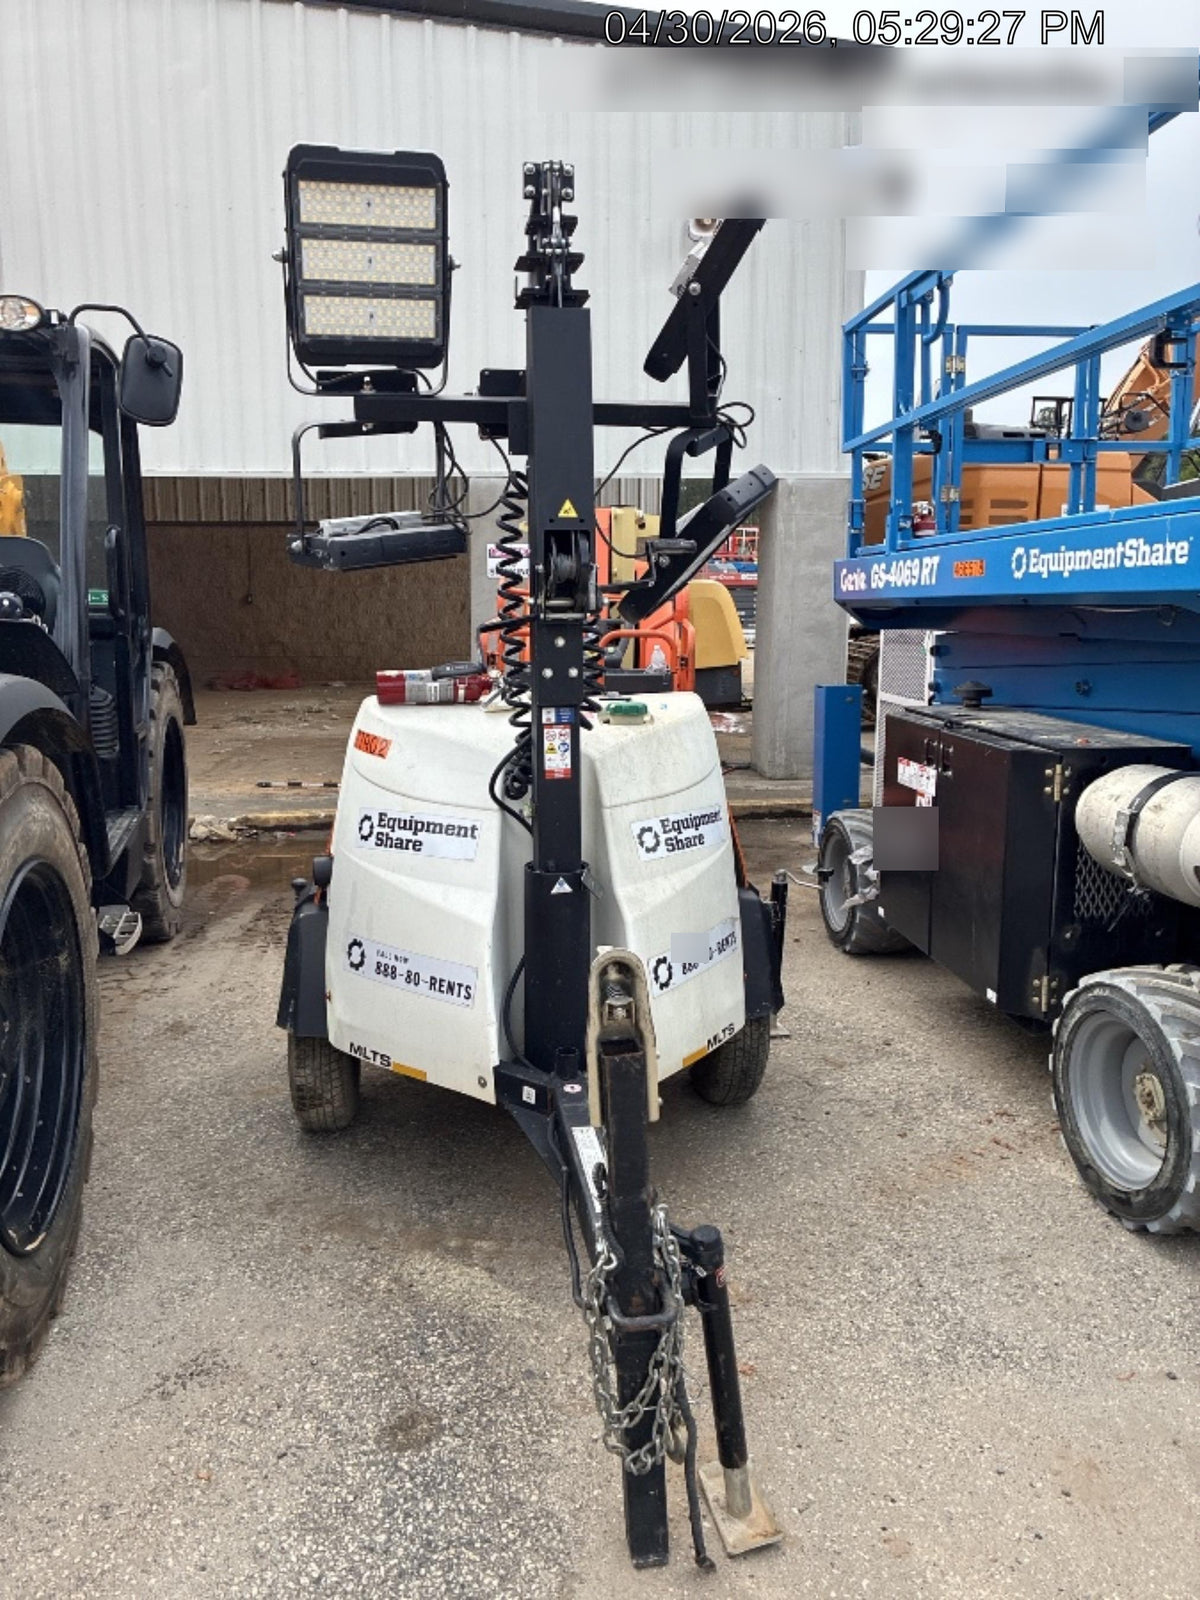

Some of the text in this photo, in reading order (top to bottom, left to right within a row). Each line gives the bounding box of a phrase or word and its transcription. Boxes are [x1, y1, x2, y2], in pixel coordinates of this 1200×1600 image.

[1028, 537, 1190, 579] EquipmentShare
[840, 555, 940, 592] Genie GS-4069 RT
[377, 812, 479, 840] Equipment
[374, 831, 423, 852] Share
[664, 833, 705, 853] Share
[374, 960, 472, 1000] 888-80-RENTS
[706, 1022, 735, 1050] MLTS
[349, 1041, 392, 1067] MLTS
